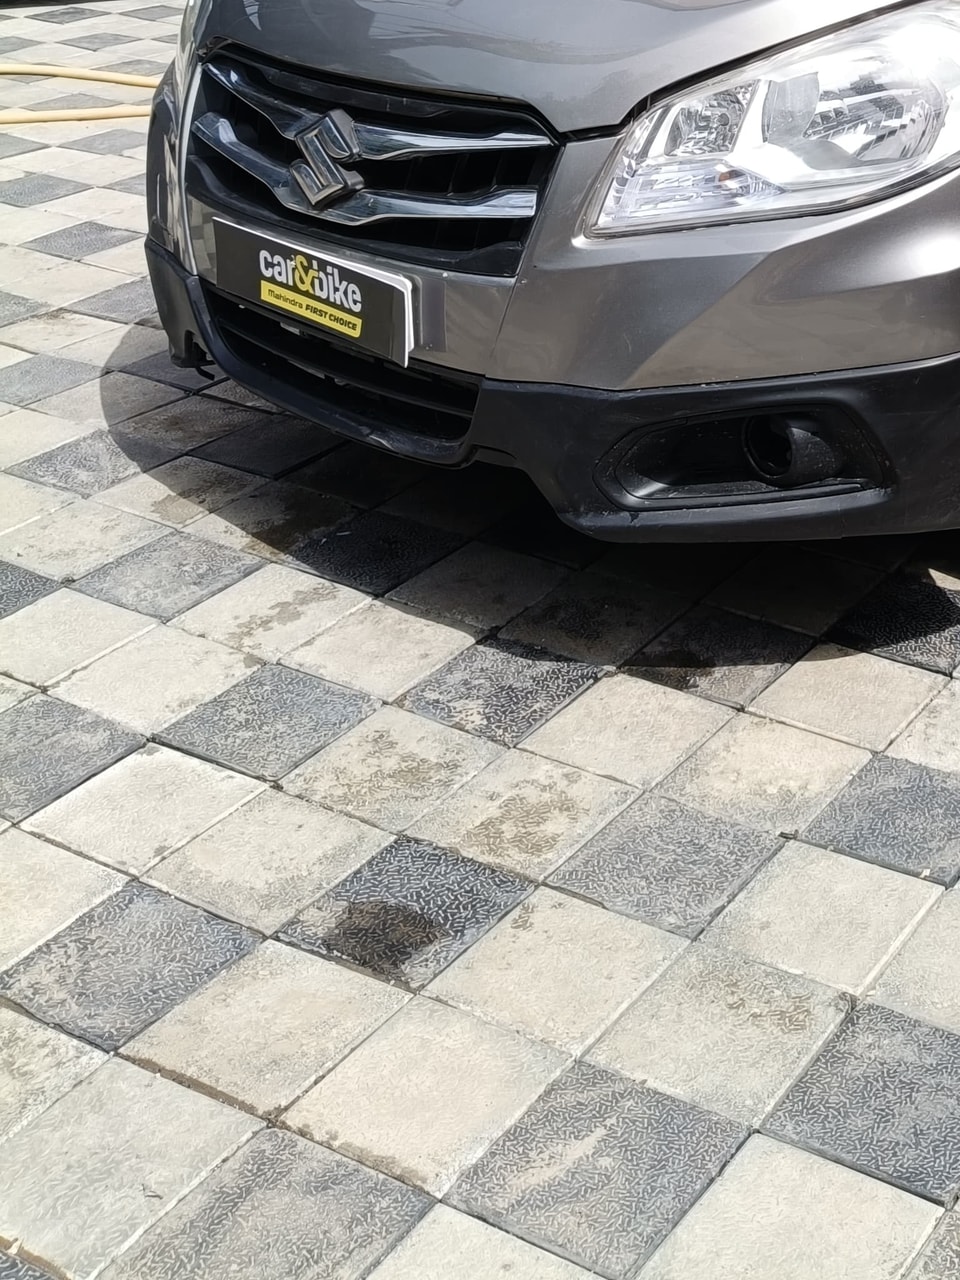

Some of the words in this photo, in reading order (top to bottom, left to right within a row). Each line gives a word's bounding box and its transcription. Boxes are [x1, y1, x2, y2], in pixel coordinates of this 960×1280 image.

[259, 249, 362, 313] car&bike
[267, 288, 303, 309] Mahindra
[305, 304, 328, 320] FIRST
[328, 312, 358, 332] CHOICE
